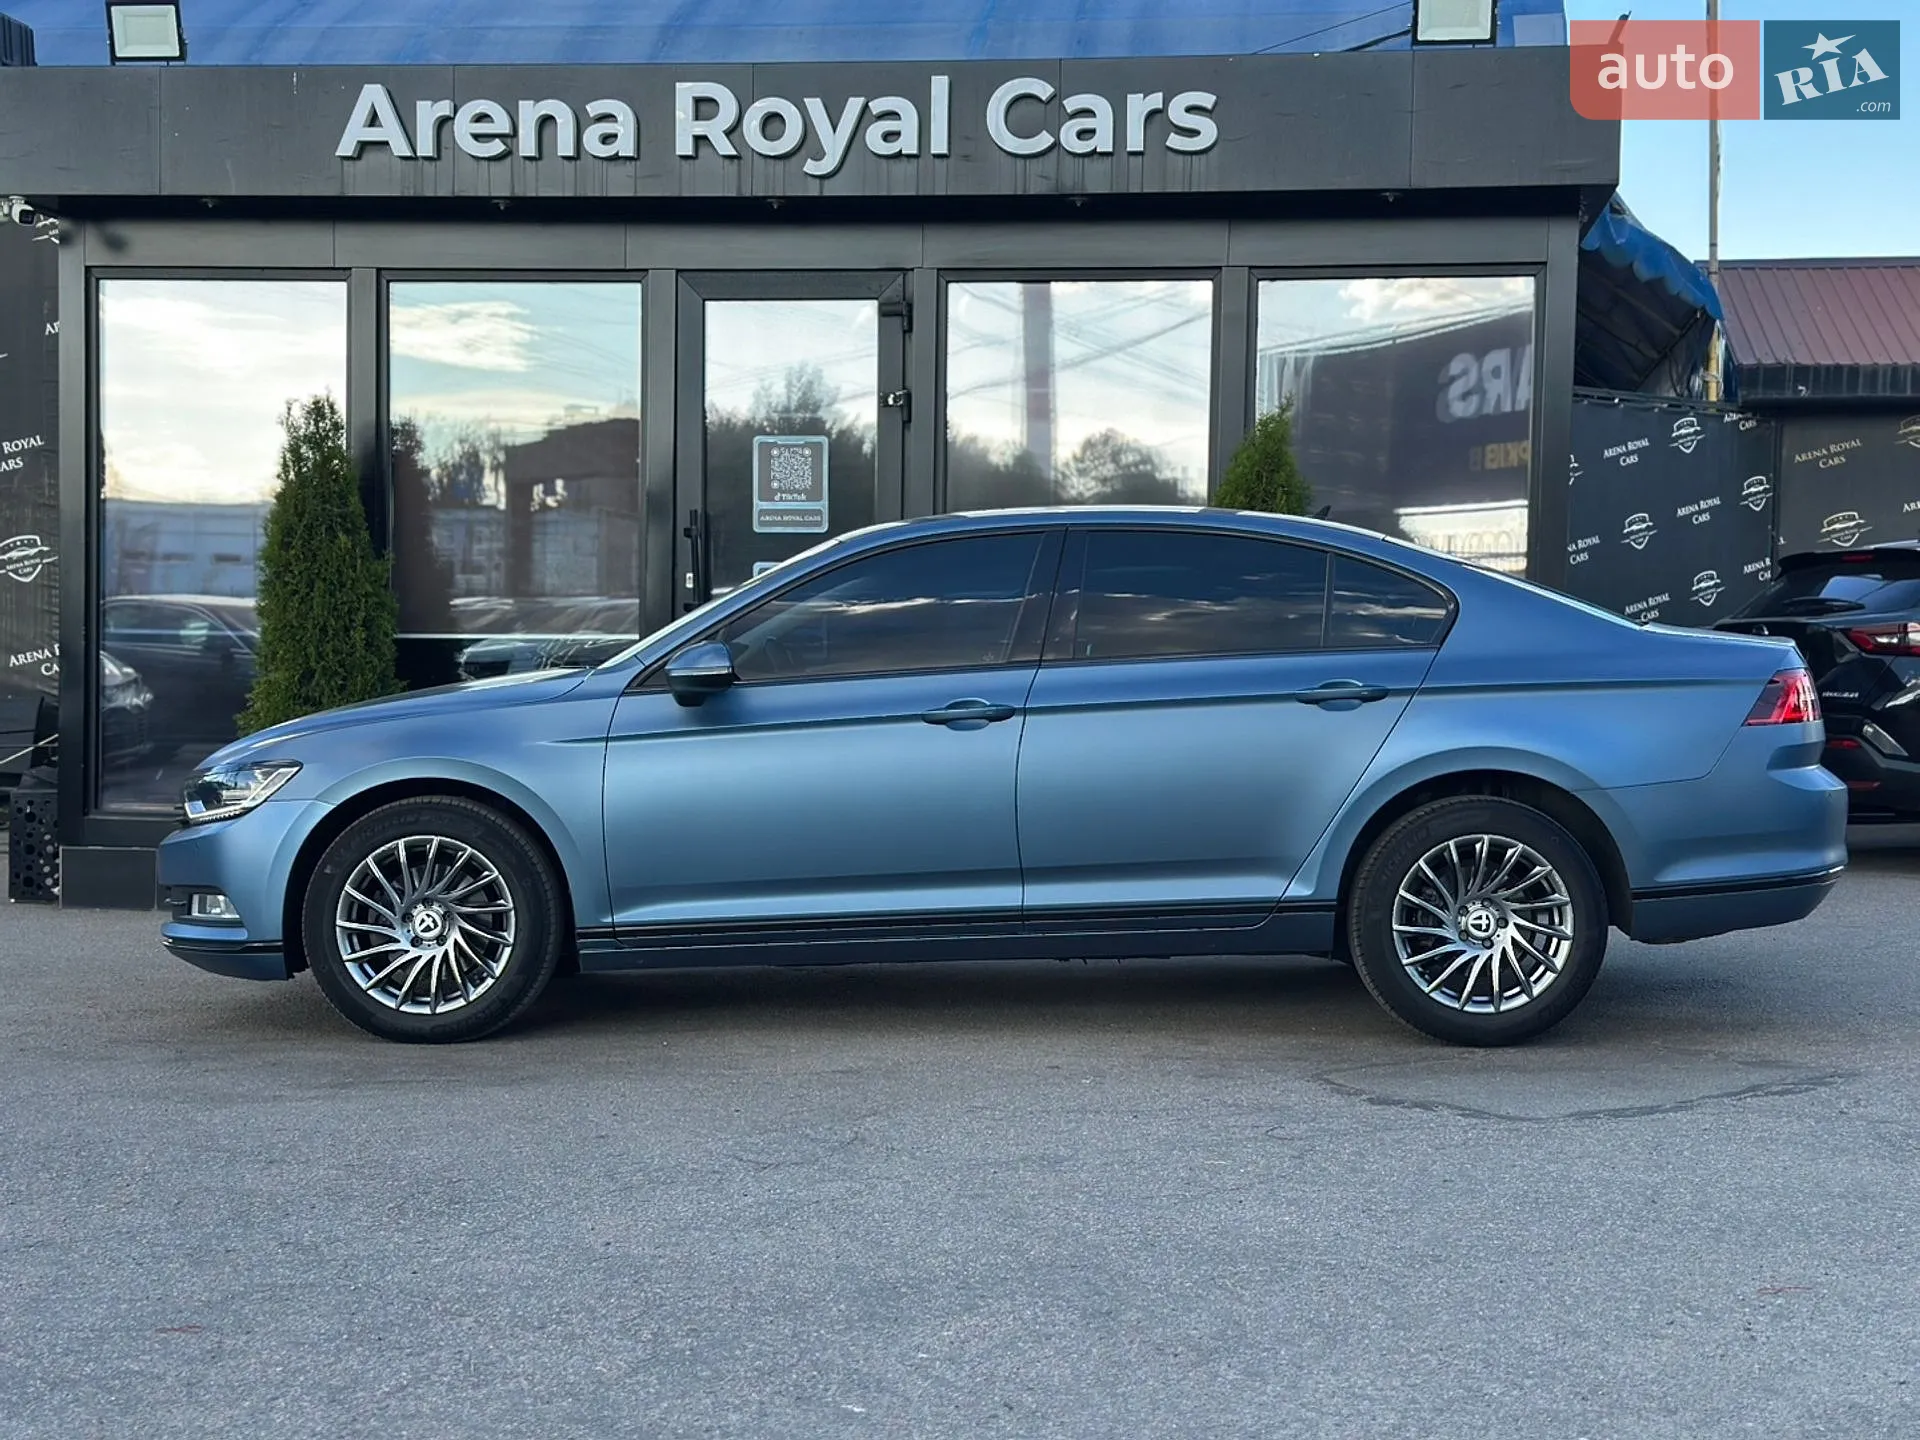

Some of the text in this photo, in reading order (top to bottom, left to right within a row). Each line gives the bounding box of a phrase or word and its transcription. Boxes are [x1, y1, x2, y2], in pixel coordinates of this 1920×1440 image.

[335, 75, 1219, 176] Arena Royal Cars
[2, 434, 45, 454] ROYAL
[1603, 437, 1650, 460] ARENA ROYAL
[1793, 438, 1863, 463] ARENA ROYAL
[1619, 453, 1639, 466] CARS
[1818, 455, 1846, 469] CARS
[1676, 496, 1721, 518] ARENA ROYAL
[1692, 511, 1711, 524] CARS
[1577, 535, 1601, 549] ROYAL
[1569, 552, 1589, 565] CARS
[1624, 592, 1671, 616] ARENA ROYAL
[1640, 608, 1660, 622] CARS
[9, 648, 53, 668] ARENA
